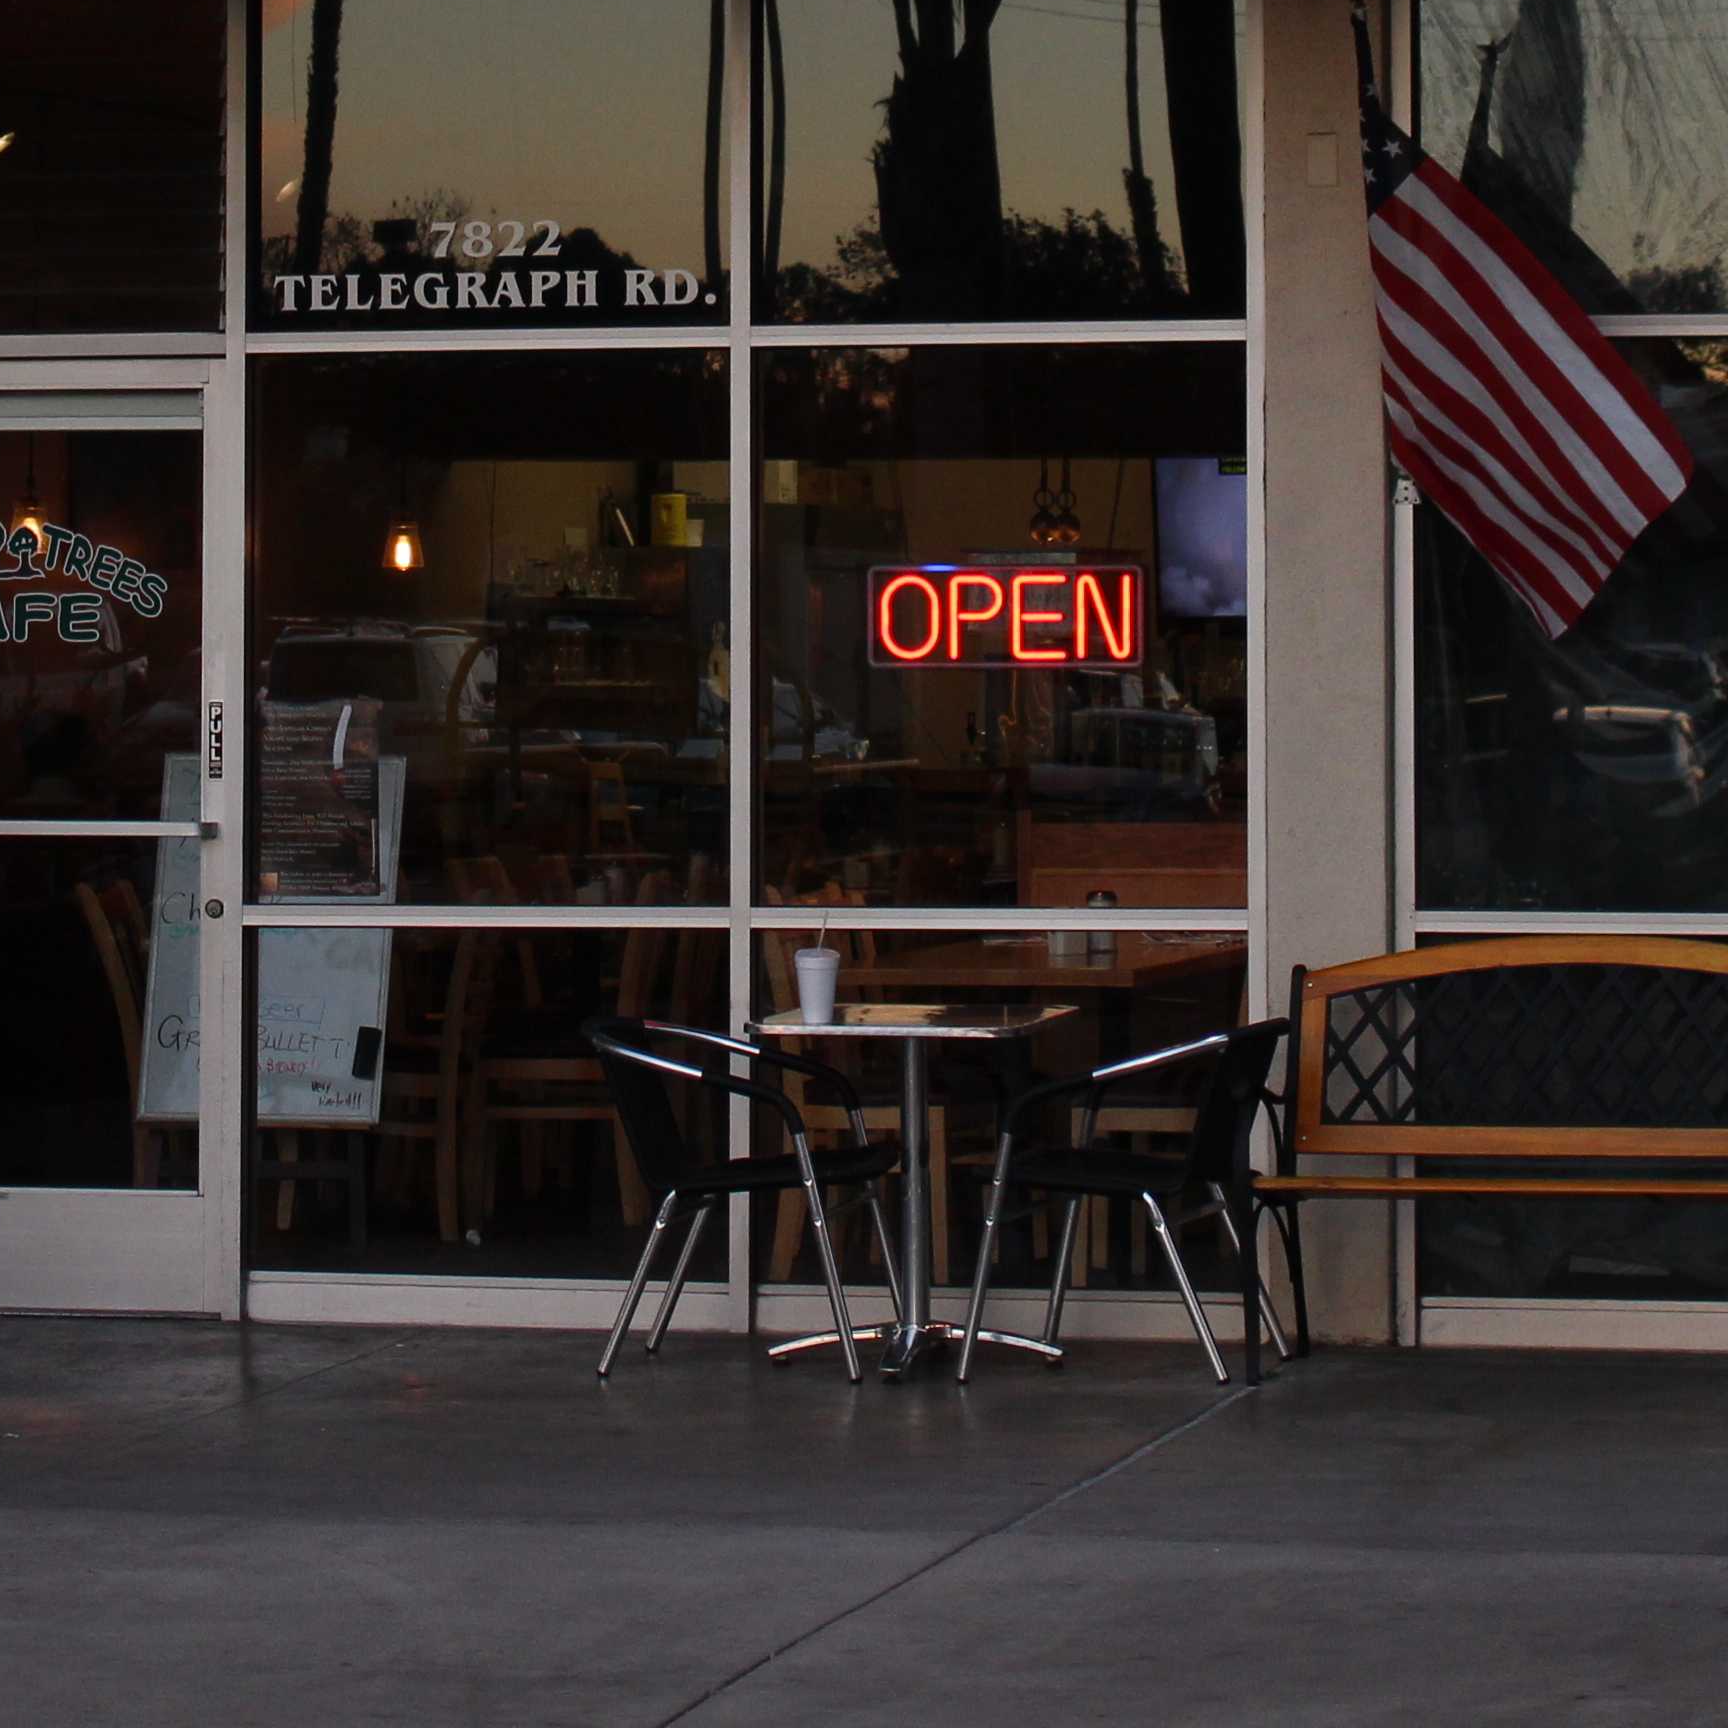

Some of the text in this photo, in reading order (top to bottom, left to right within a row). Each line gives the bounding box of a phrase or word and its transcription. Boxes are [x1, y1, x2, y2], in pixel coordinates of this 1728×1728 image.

[429, 218, 563, 260] 7822
[272, 268, 718, 312] TELEGRAPH RD.
[42, 522, 168, 617] TREES
[879, 573, 1133, 661] OPEN
[210, 706, 223, 761] PULL
